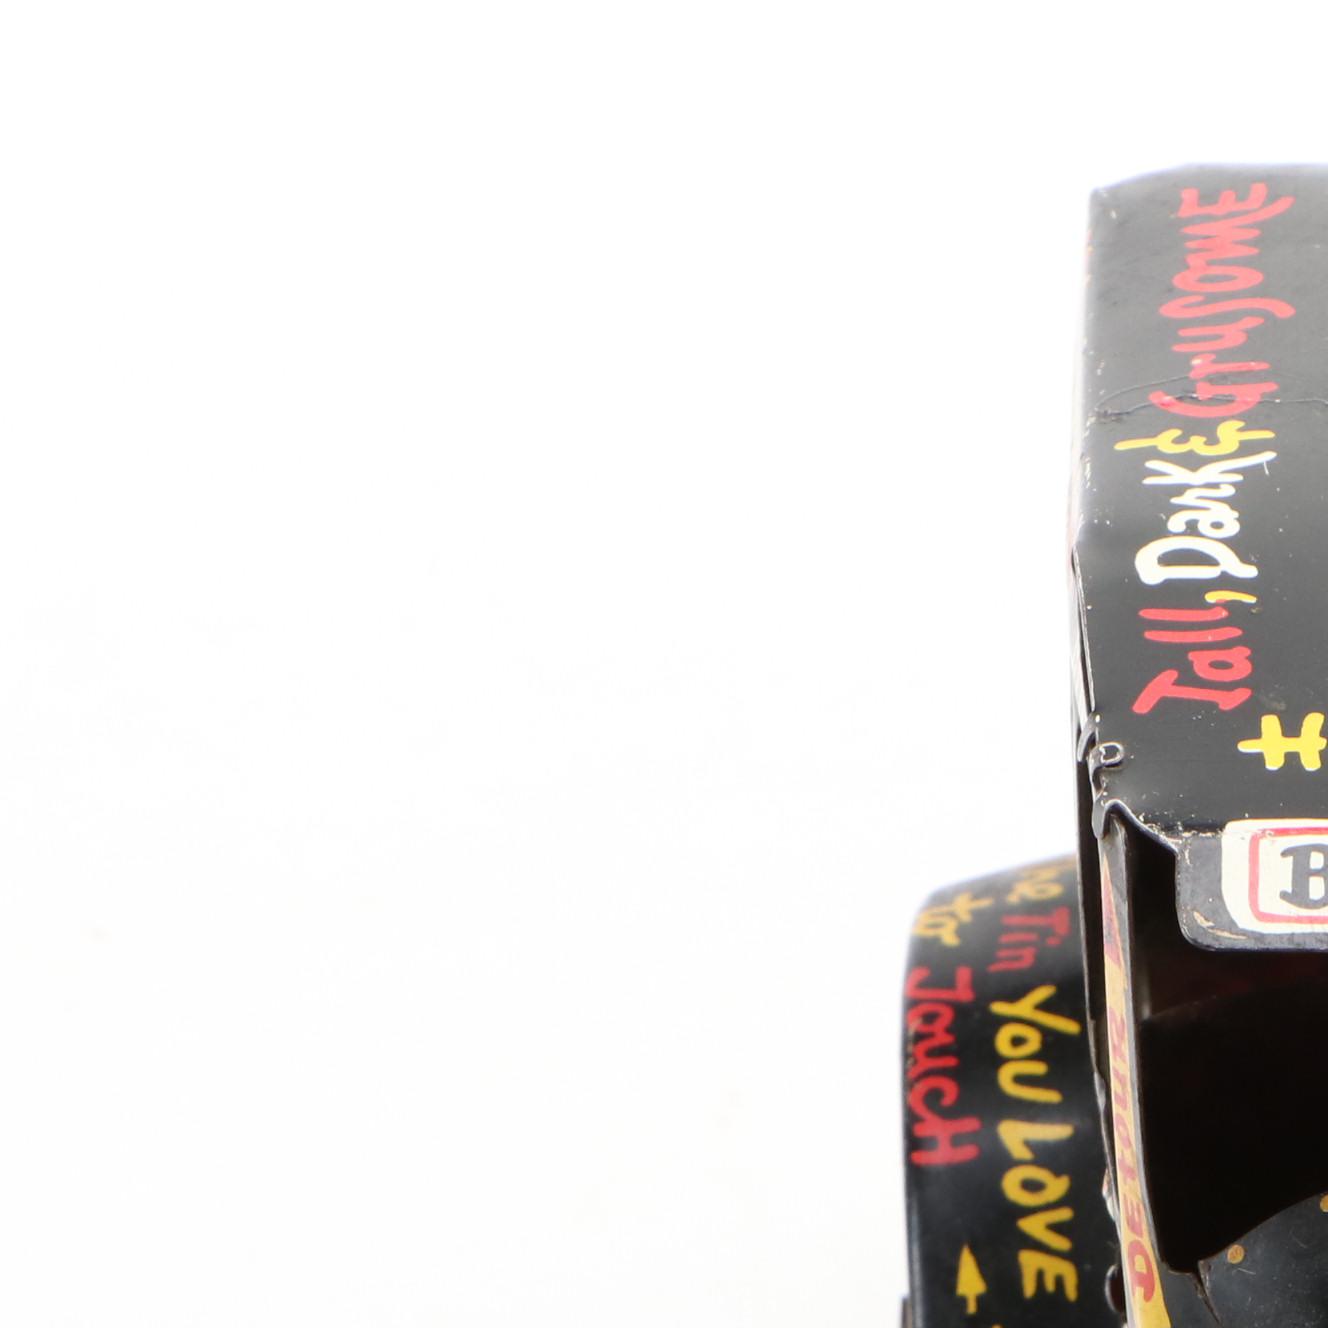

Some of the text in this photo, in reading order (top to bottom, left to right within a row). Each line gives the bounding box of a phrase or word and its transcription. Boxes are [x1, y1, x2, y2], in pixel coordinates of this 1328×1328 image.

[1113, 419, 1276, 457] &
[986, 905, 1071, 974] Tin
[989, 983, 1082, 1103] YOU
[996, 1117, 1079, 1303] LOVE
